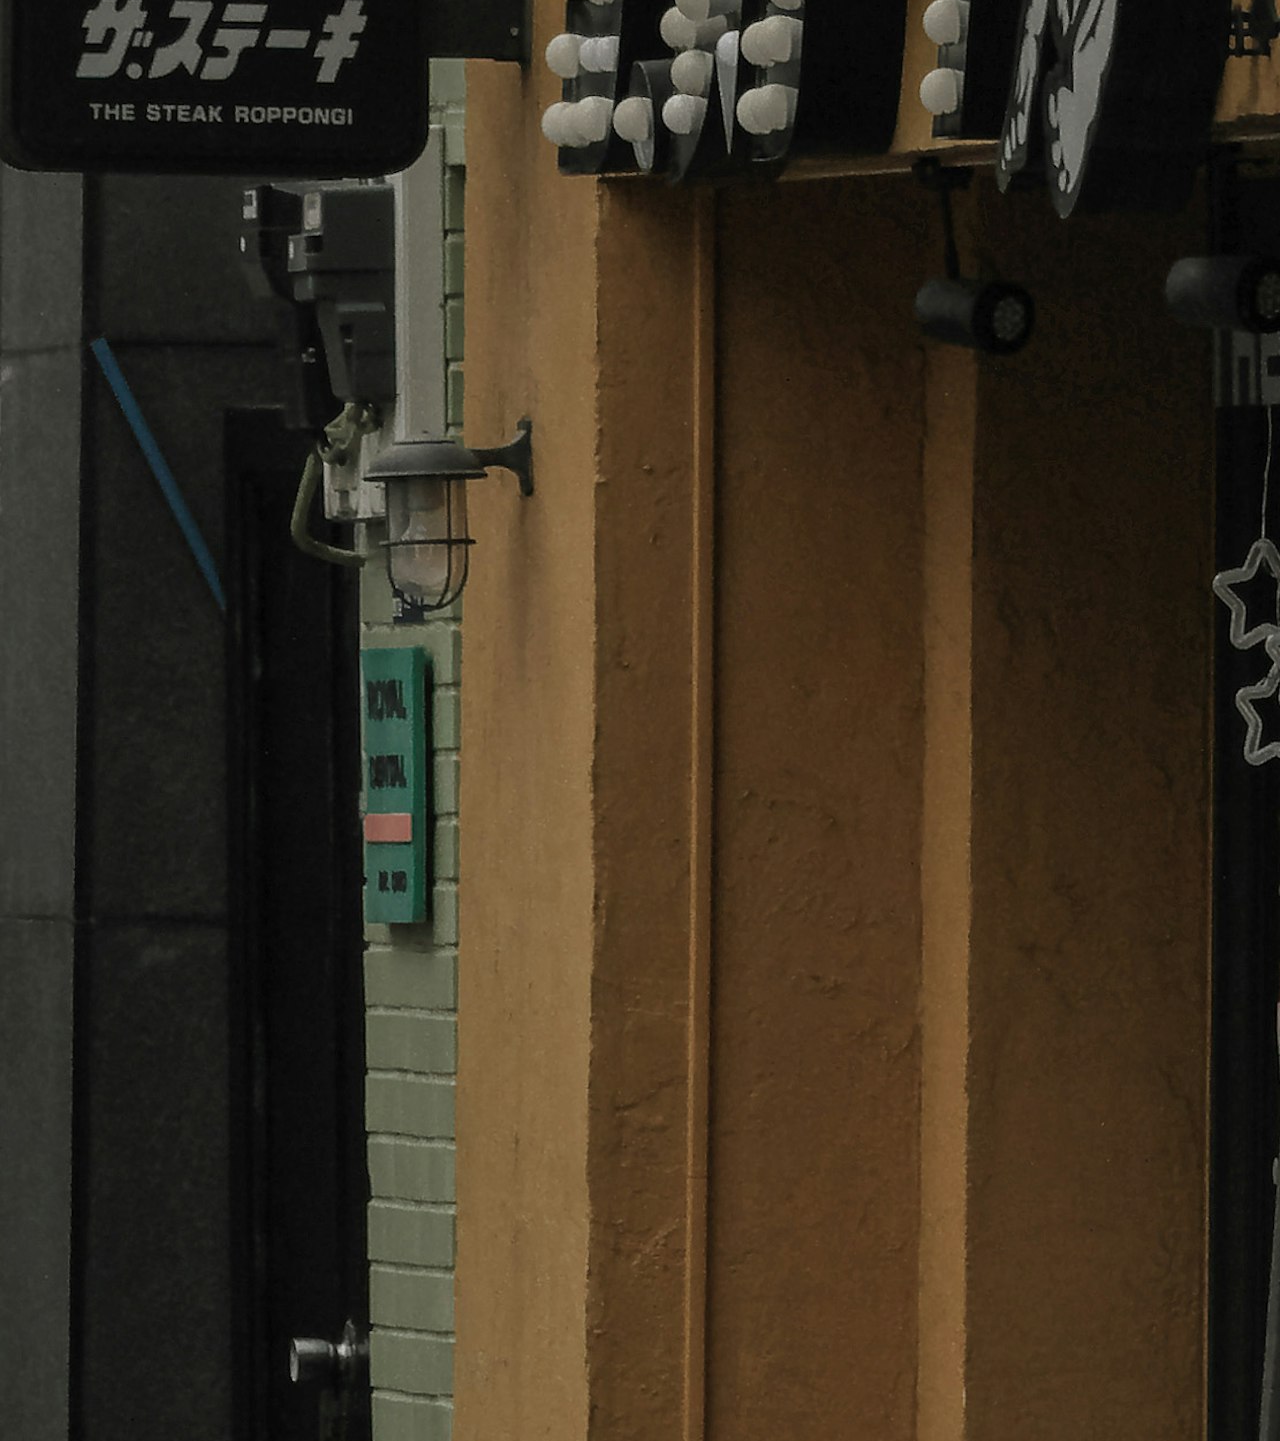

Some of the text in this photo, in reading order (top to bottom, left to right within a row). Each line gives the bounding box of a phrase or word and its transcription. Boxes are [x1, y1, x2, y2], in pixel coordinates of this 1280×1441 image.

[89, 103, 354, 127] THE STEAK ROPPONGI
